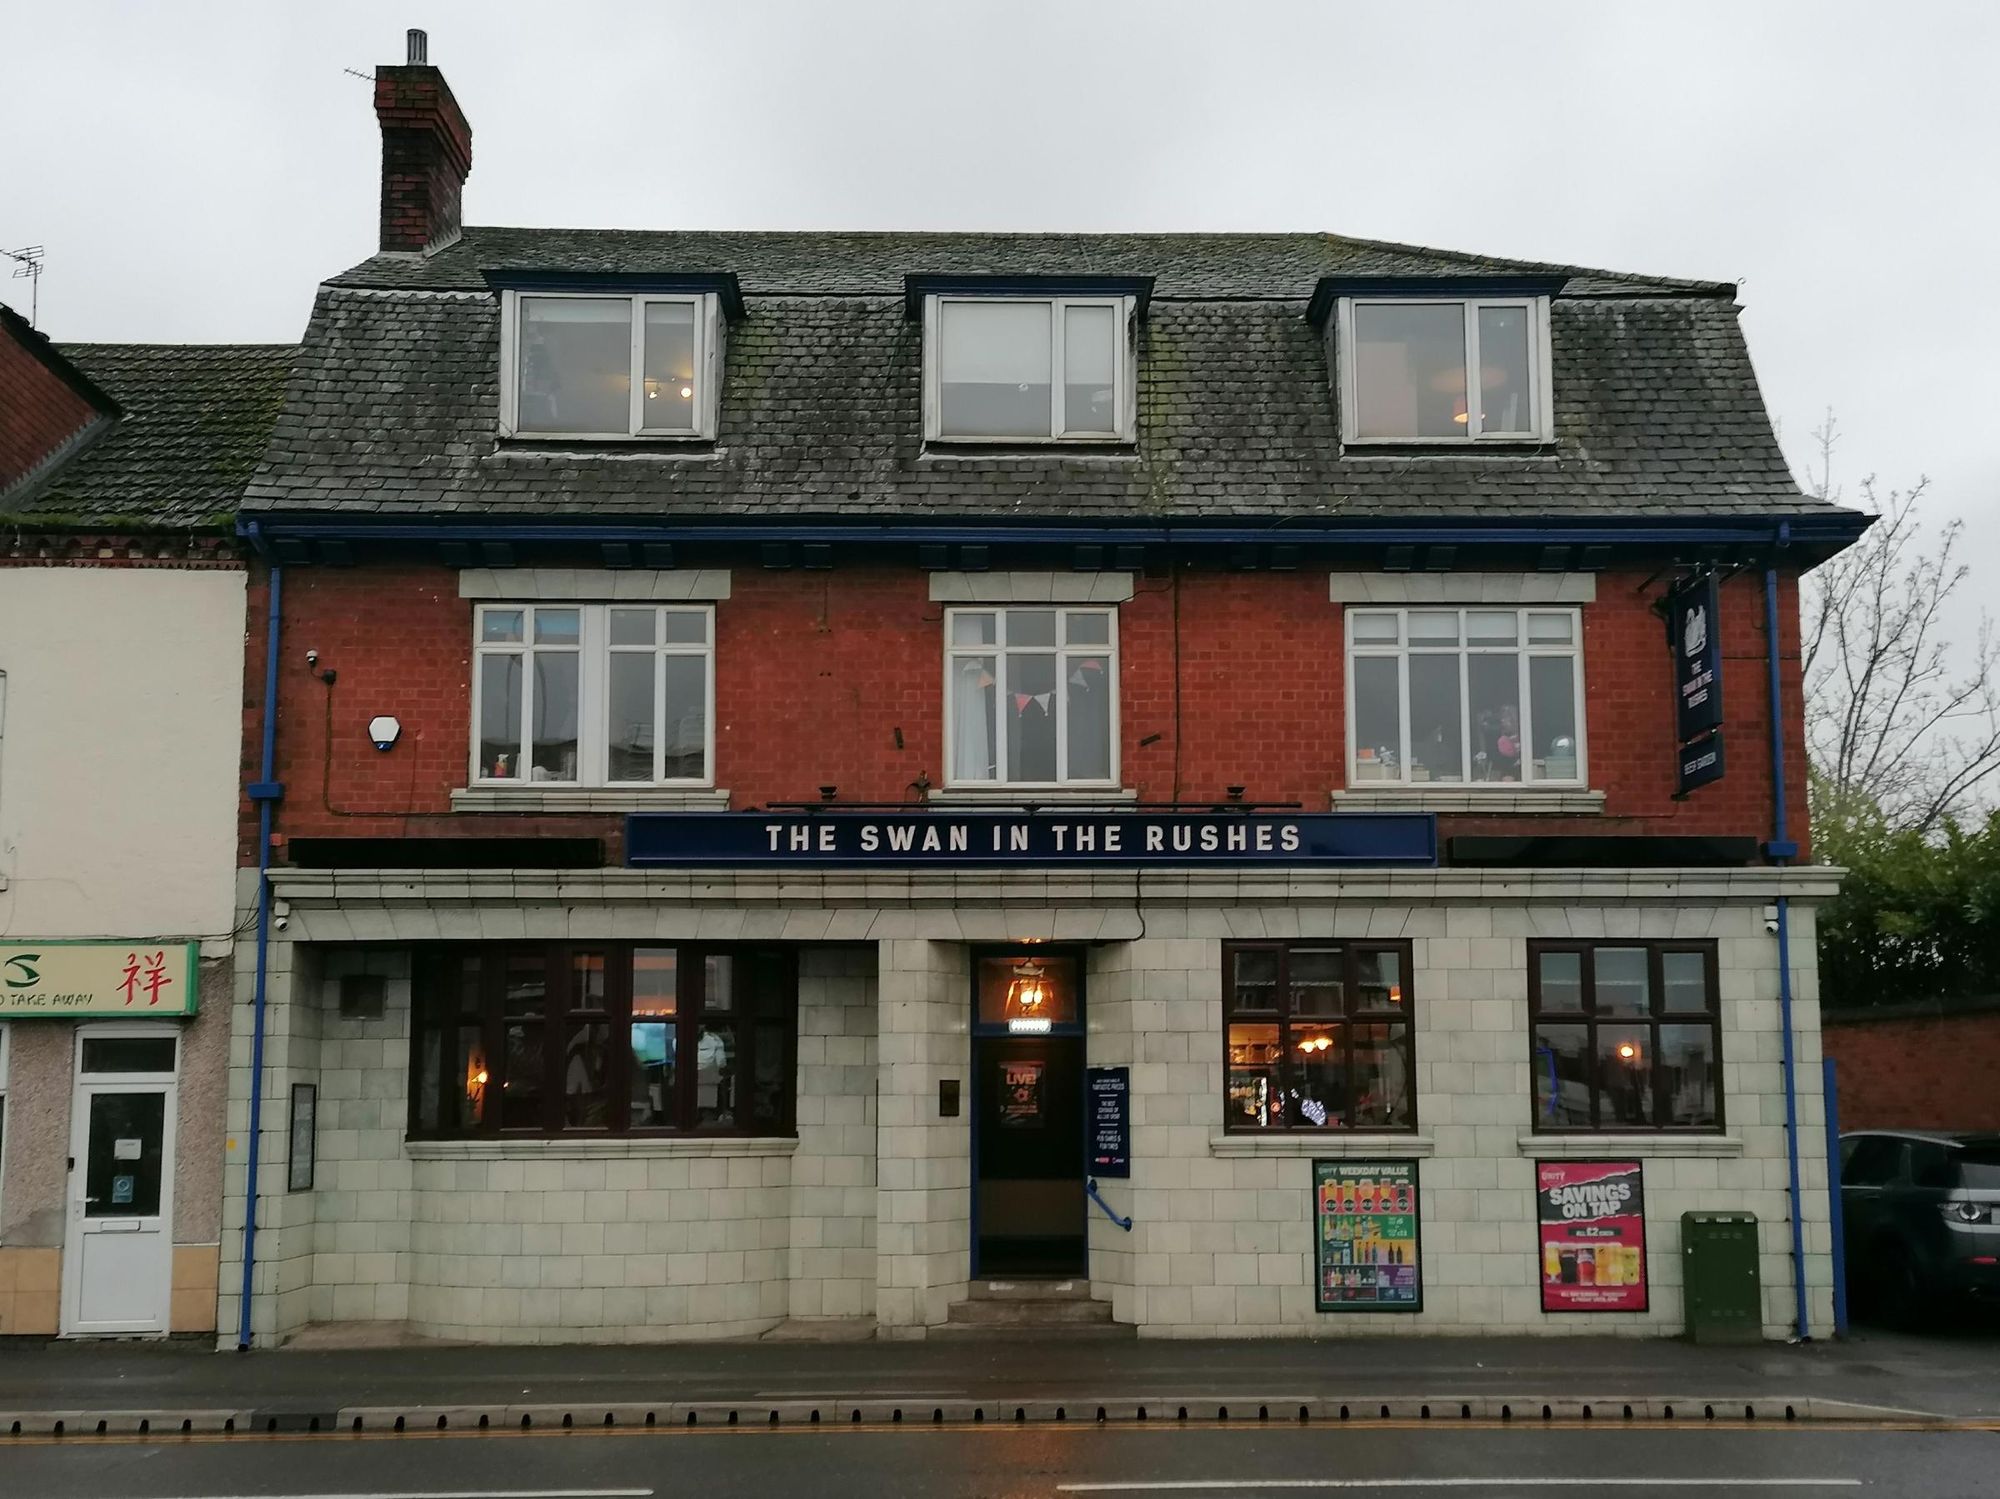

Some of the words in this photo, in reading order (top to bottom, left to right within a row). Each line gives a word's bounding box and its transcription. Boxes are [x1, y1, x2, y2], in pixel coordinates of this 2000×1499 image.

[765, 824, 837, 852] THE
[860, 824, 968, 852] SWAN
[993, 824, 1029, 852] IN
[1051, 824, 1122, 852] THE
[1146, 824, 1300, 852] RUSHES
[115, 950, 173, 1006] 祥
[11, 993, 47, 1006] TAKE
[52, 993, 94, 1006] AWAY
[1339, 1166, 1380, 1176] WEEKDAY
[1381, 1166, 1409, 1176] VALUE
[1549, 1183, 1632, 1206] SAVINGS
[1562, 1202, 1588, 1218] ON
[1589, 1200, 1622, 1216] TAP
